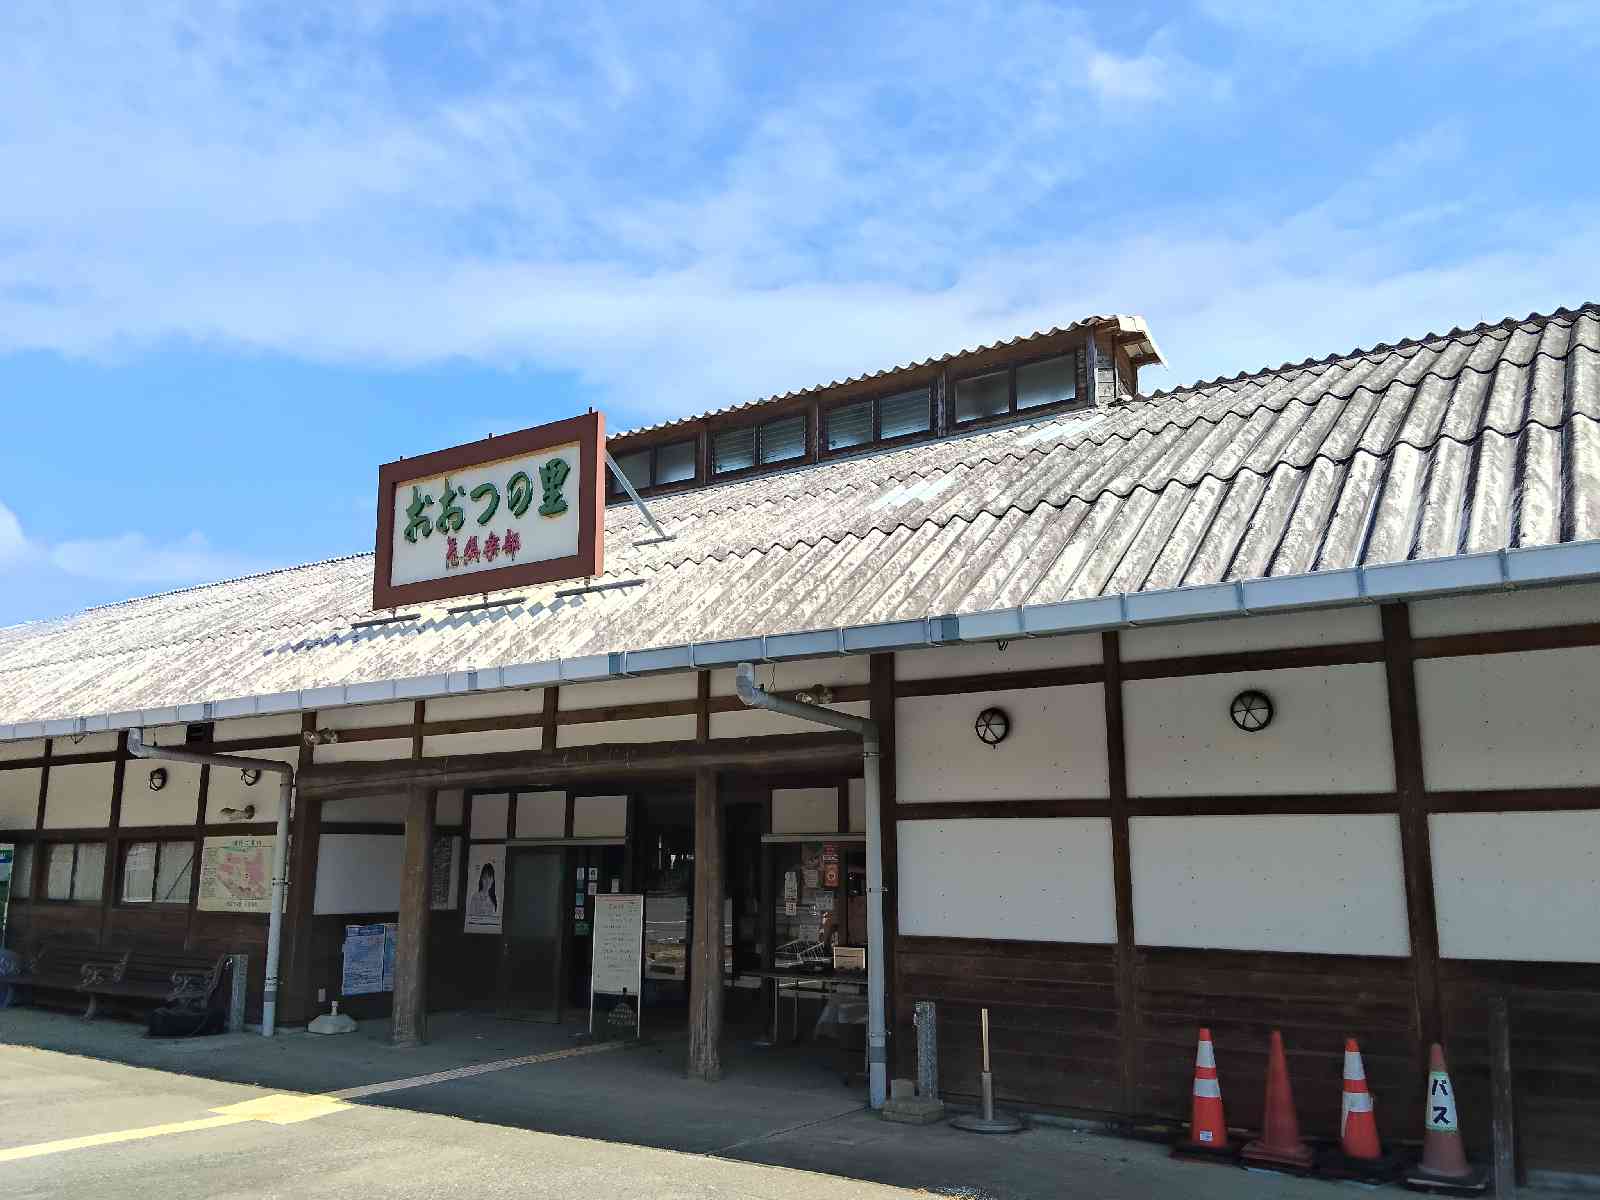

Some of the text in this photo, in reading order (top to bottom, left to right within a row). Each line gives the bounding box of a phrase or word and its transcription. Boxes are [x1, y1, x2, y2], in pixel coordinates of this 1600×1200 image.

[404, 458, 570, 543] おおつの里
[1431, 1079, 1450, 1124] バス
